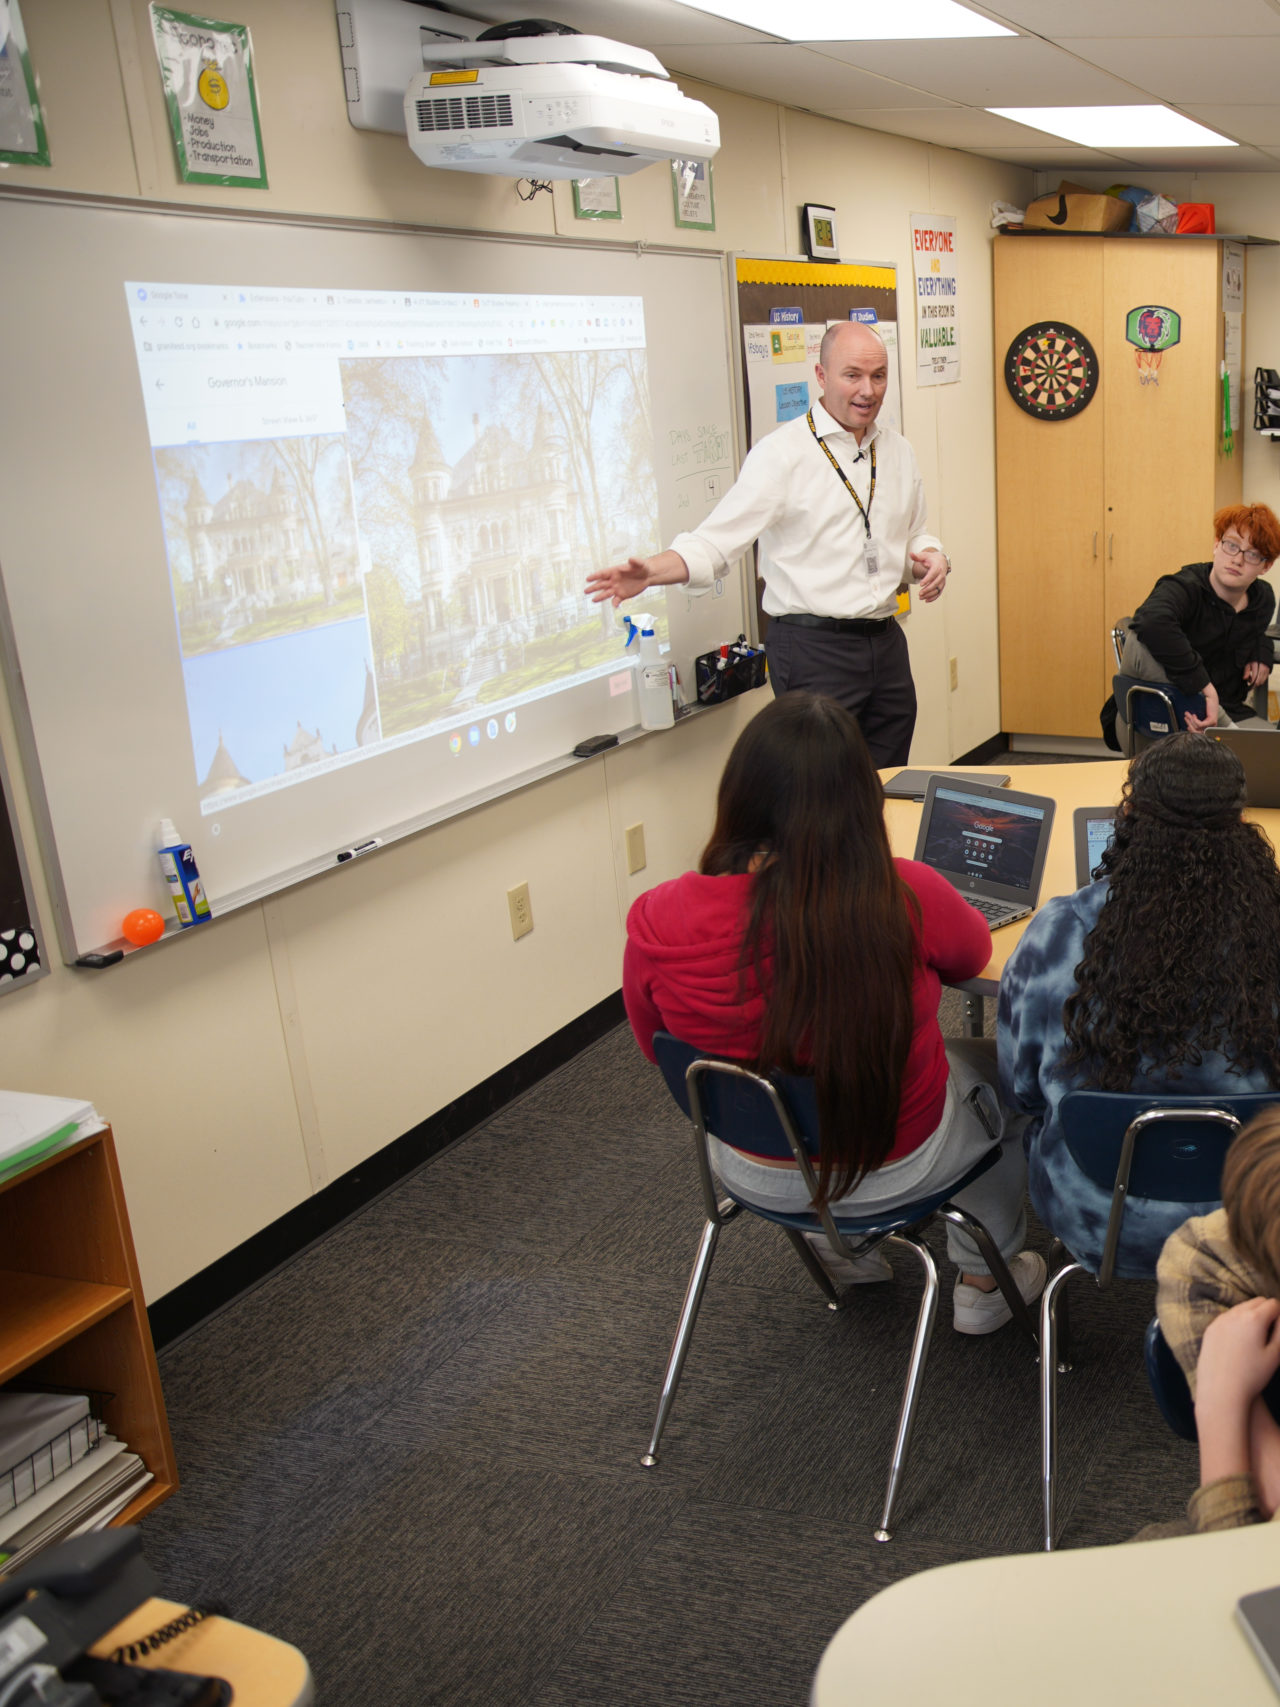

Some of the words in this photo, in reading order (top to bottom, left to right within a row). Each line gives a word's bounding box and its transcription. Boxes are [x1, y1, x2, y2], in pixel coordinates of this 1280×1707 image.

[914, 229, 954, 253] EVERYONE
[931, 258, 941, 273] AND
[918, 277, 956, 296] EVERYTHING
[773, 312, 780, 322] US
[781, 312, 799, 323] History
[922, 305, 926, 318] IN
[927, 305, 938, 318] THIS
[938, 305, 950, 318] ROOM
[950, 304, 955, 317] IS
[207, 376, 253, 389] Governor's
[254, 376, 288, 387] Mansion
[974, 820, 994, 832] Google
